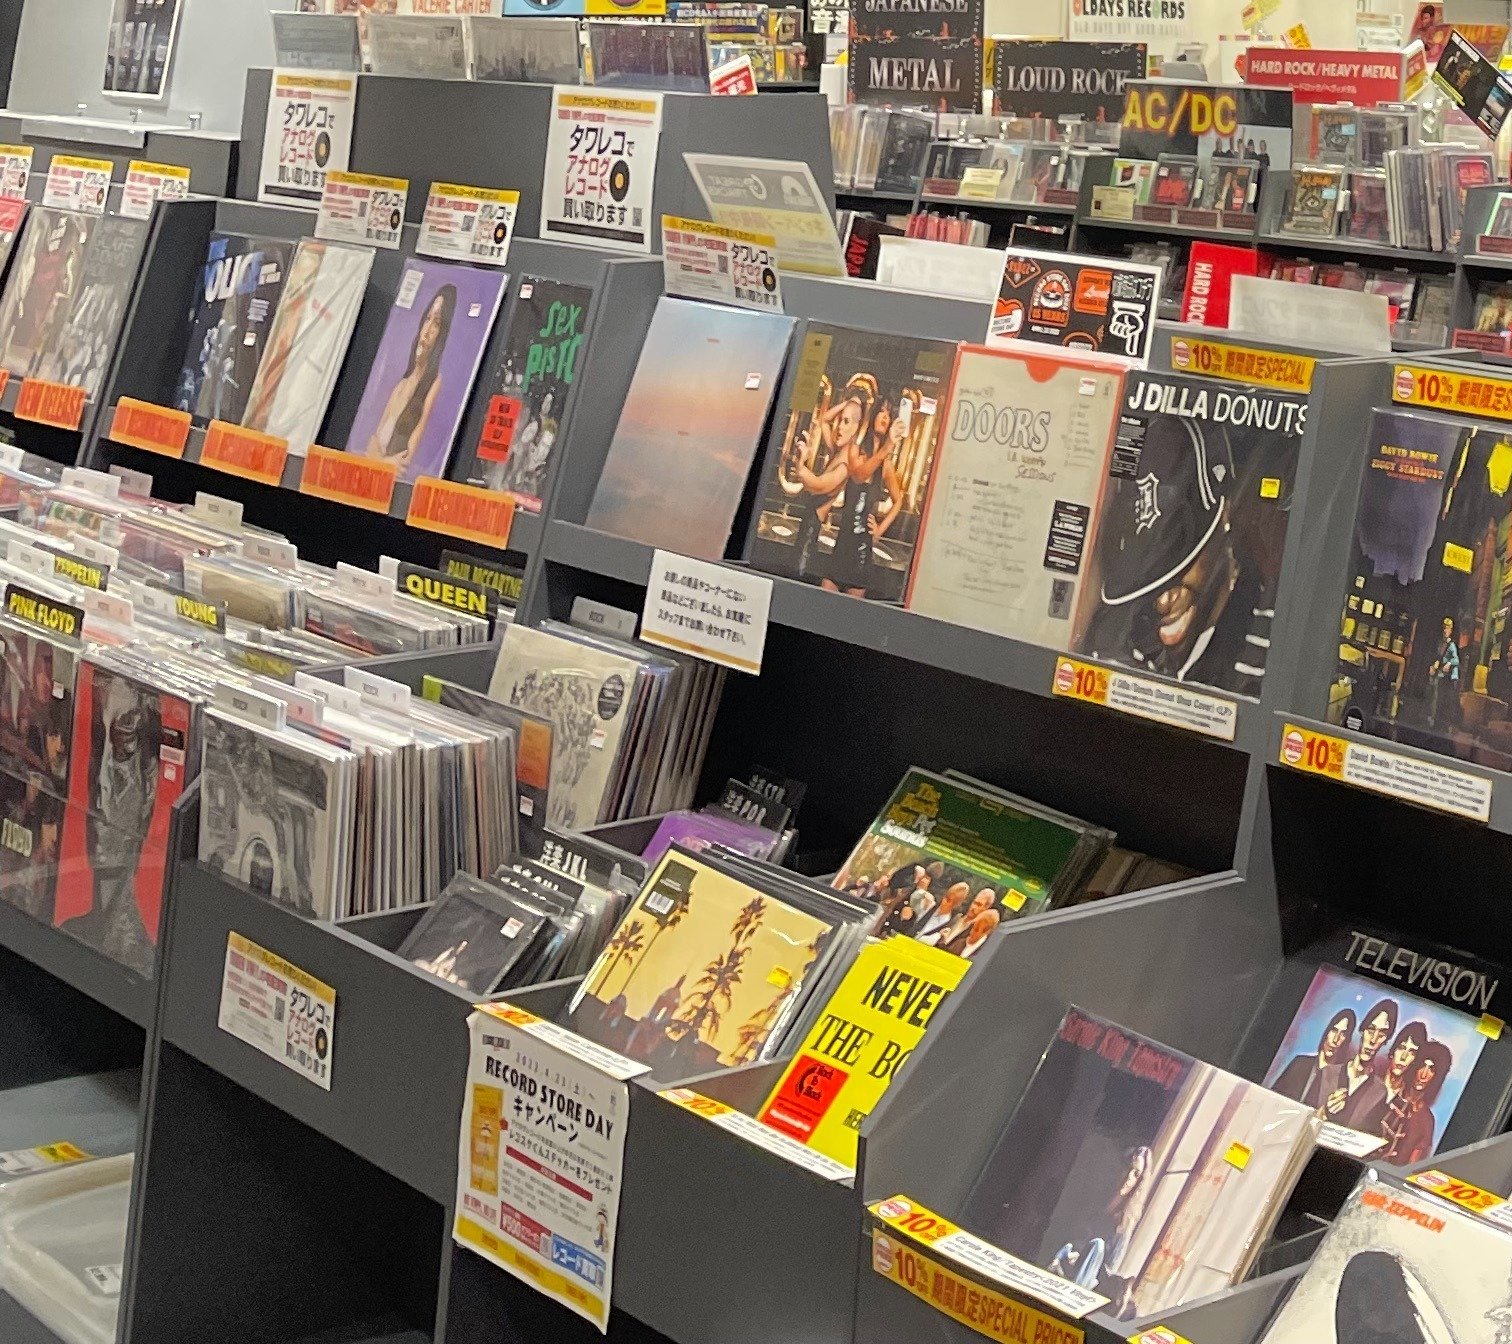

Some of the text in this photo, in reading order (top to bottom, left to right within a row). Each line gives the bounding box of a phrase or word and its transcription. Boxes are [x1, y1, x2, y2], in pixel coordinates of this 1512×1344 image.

[868, 56, 960, 92] METAL
[1007, 65, 1131, 97] LOUD ROCK
[1250, 59, 1282, 76] HARD
[1361, 63, 1399, 81] METAL
[1122, 90, 1239, 137] AC/DC
[569, 124, 635, 157] タワレコで
[566, 154, 612, 177] アナログ
[564, 174, 608, 200] レコード
[1190, 261, 1214, 296] HARD
[951, 399, 1051, 453] DOORS
[1128, 381, 1309, 436] J DILLA DONUTS
[9, 591, 77, 635] PINK FLOYD
[174, 594, 218, 626] YOUNG
[406, 573, 487, 615] QUEEN
[1343, 931, 1499, 1010] TELEVISION
[811, 1013, 874, 1068] THE
[485, 1054, 614, 1141] RECORD STORE DAY
